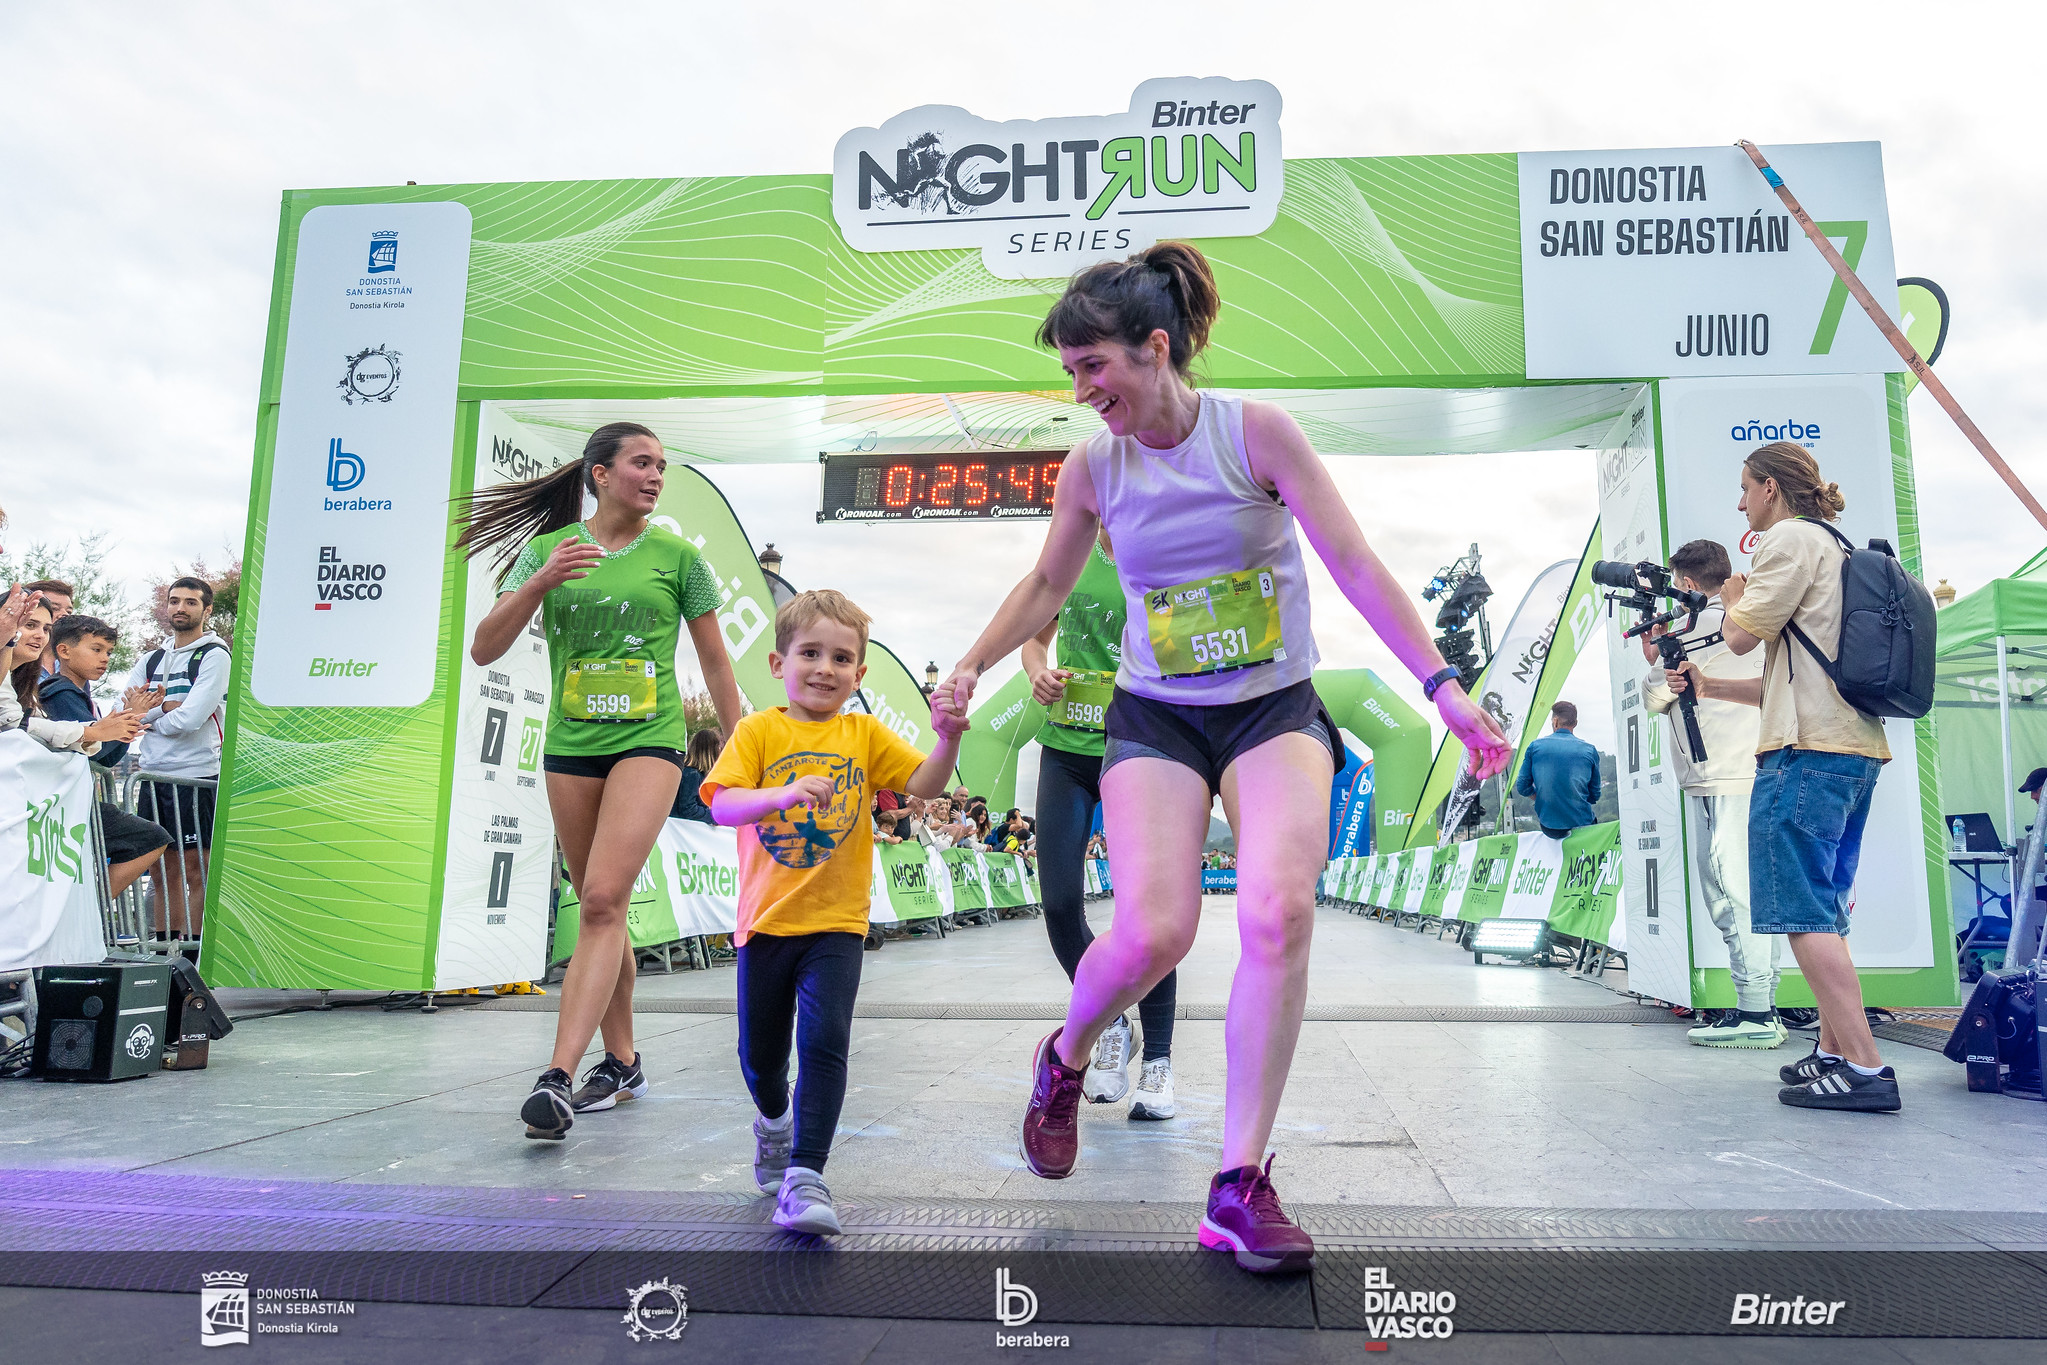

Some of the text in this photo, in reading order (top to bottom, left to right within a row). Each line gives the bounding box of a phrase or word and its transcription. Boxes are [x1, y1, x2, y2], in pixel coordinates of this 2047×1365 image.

[1151, 99, 1256, 129] Binter
[1549, 164, 1708, 205] DONOSTIA
[1007, 228, 1132, 255] SERIES
[1540, 209, 1789, 257] SAN SEBASTIÁN
[345, 286, 413, 297] SAN SEBASTIÁN
[359, 277, 401, 286] DONOSTIA
[1804, 220, 1868, 355] 7
[349, 301, 405, 310] Donostia Kirola
[1675, 312, 1769, 357] JUNIO
[1731, 418, 1821, 441] añarbe
[324, 496, 392, 511] berabera
[835, 507, 902, 520] KRONOAK.com
[912, 505, 979, 519] KRONOAK.com
[990, 504, 1052, 518] KRONOAK.co
[319, 546, 342, 563] EL
[317, 563, 387, 582] DIARIO
[317, 583, 383, 601] VASCO
[1262, 578, 1270, 591] 3
[1190, 626, 1250, 663] 5531
[308, 657, 378, 677] Binter
[488, 669, 510, 687] DONOSTIA
[647, 665, 653, 675] 3
[480, 684, 490, 698] SAN
[586, 694, 631, 713] 5599
[989, 697, 1025, 732] Binter
[1066, 701, 1104, 724] 5598
[1362, 697, 1400, 730] Binter
[487, 716, 501, 757] 7
[519, 725, 541, 765] 27
[1648, 715, 1659, 761] 27
[769, 757, 828, 780] LANZAROTE
[817, 794, 848, 820] Surf
[491, 814, 519, 829] LAS PALMAS
[1337, 800, 1365, 859] berabera
[483, 830, 491, 842] DE
[496, 860, 505, 901] 1
[676, 851, 740, 897] Binter
[1512, 858, 1554, 896] Binter
